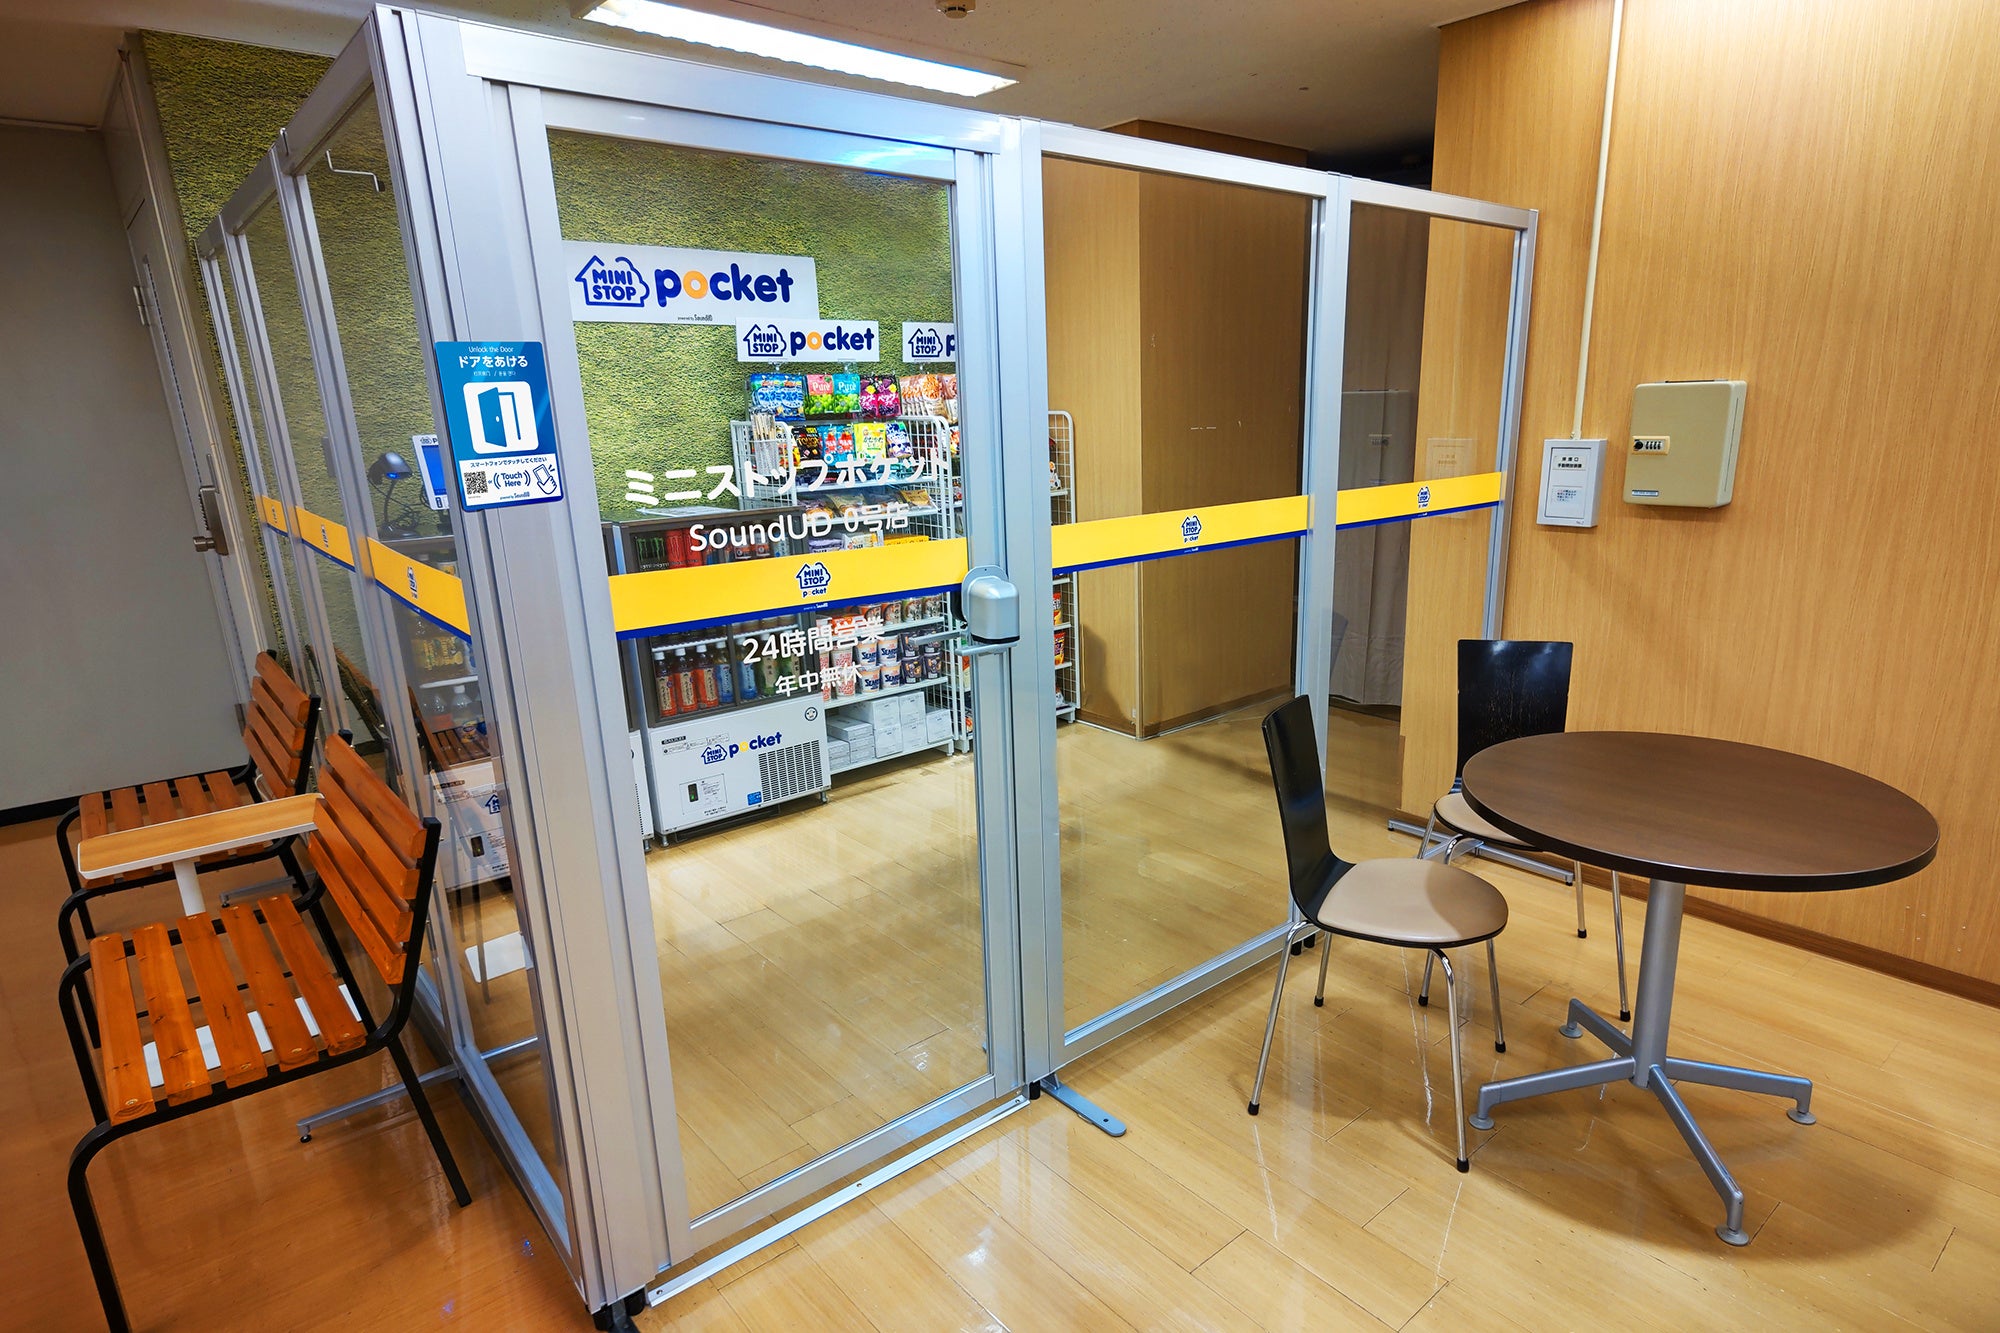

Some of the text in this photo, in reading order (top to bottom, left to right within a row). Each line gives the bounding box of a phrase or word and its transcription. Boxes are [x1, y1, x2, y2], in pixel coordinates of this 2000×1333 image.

[592, 268, 633, 286] MINI
[654, 262, 794, 308] pocket
[592, 285, 637, 301] STOP
[753, 332, 777, 343] MINI
[790, 325, 875, 357] pocket
[916, 336, 936, 345] MINI
[753, 342, 779, 353] STOP
[915, 345, 937, 354] STOP
[458, 355, 529, 368] ドアをあける
[470, 456, 547, 468] スマートフォンでタッチしてください
[500, 471, 523, 480] Touch
[625, 448, 949, 506] ミニストップポケット
[689, 501, 909, 552] SoundUD 0号店
[1185, 526, 1198, 534] STOP
[803, 568, 823, 578] MINI
[803, 576, 825, 586] STOP
[741, 615, 886, 665] 24時間営業
[775, 661, 863, 697] 年中無休
[728, 731, 783, 759] pocket
[706, 747, 722, 757] MINI
[706, 753, 723, 762] STOP
